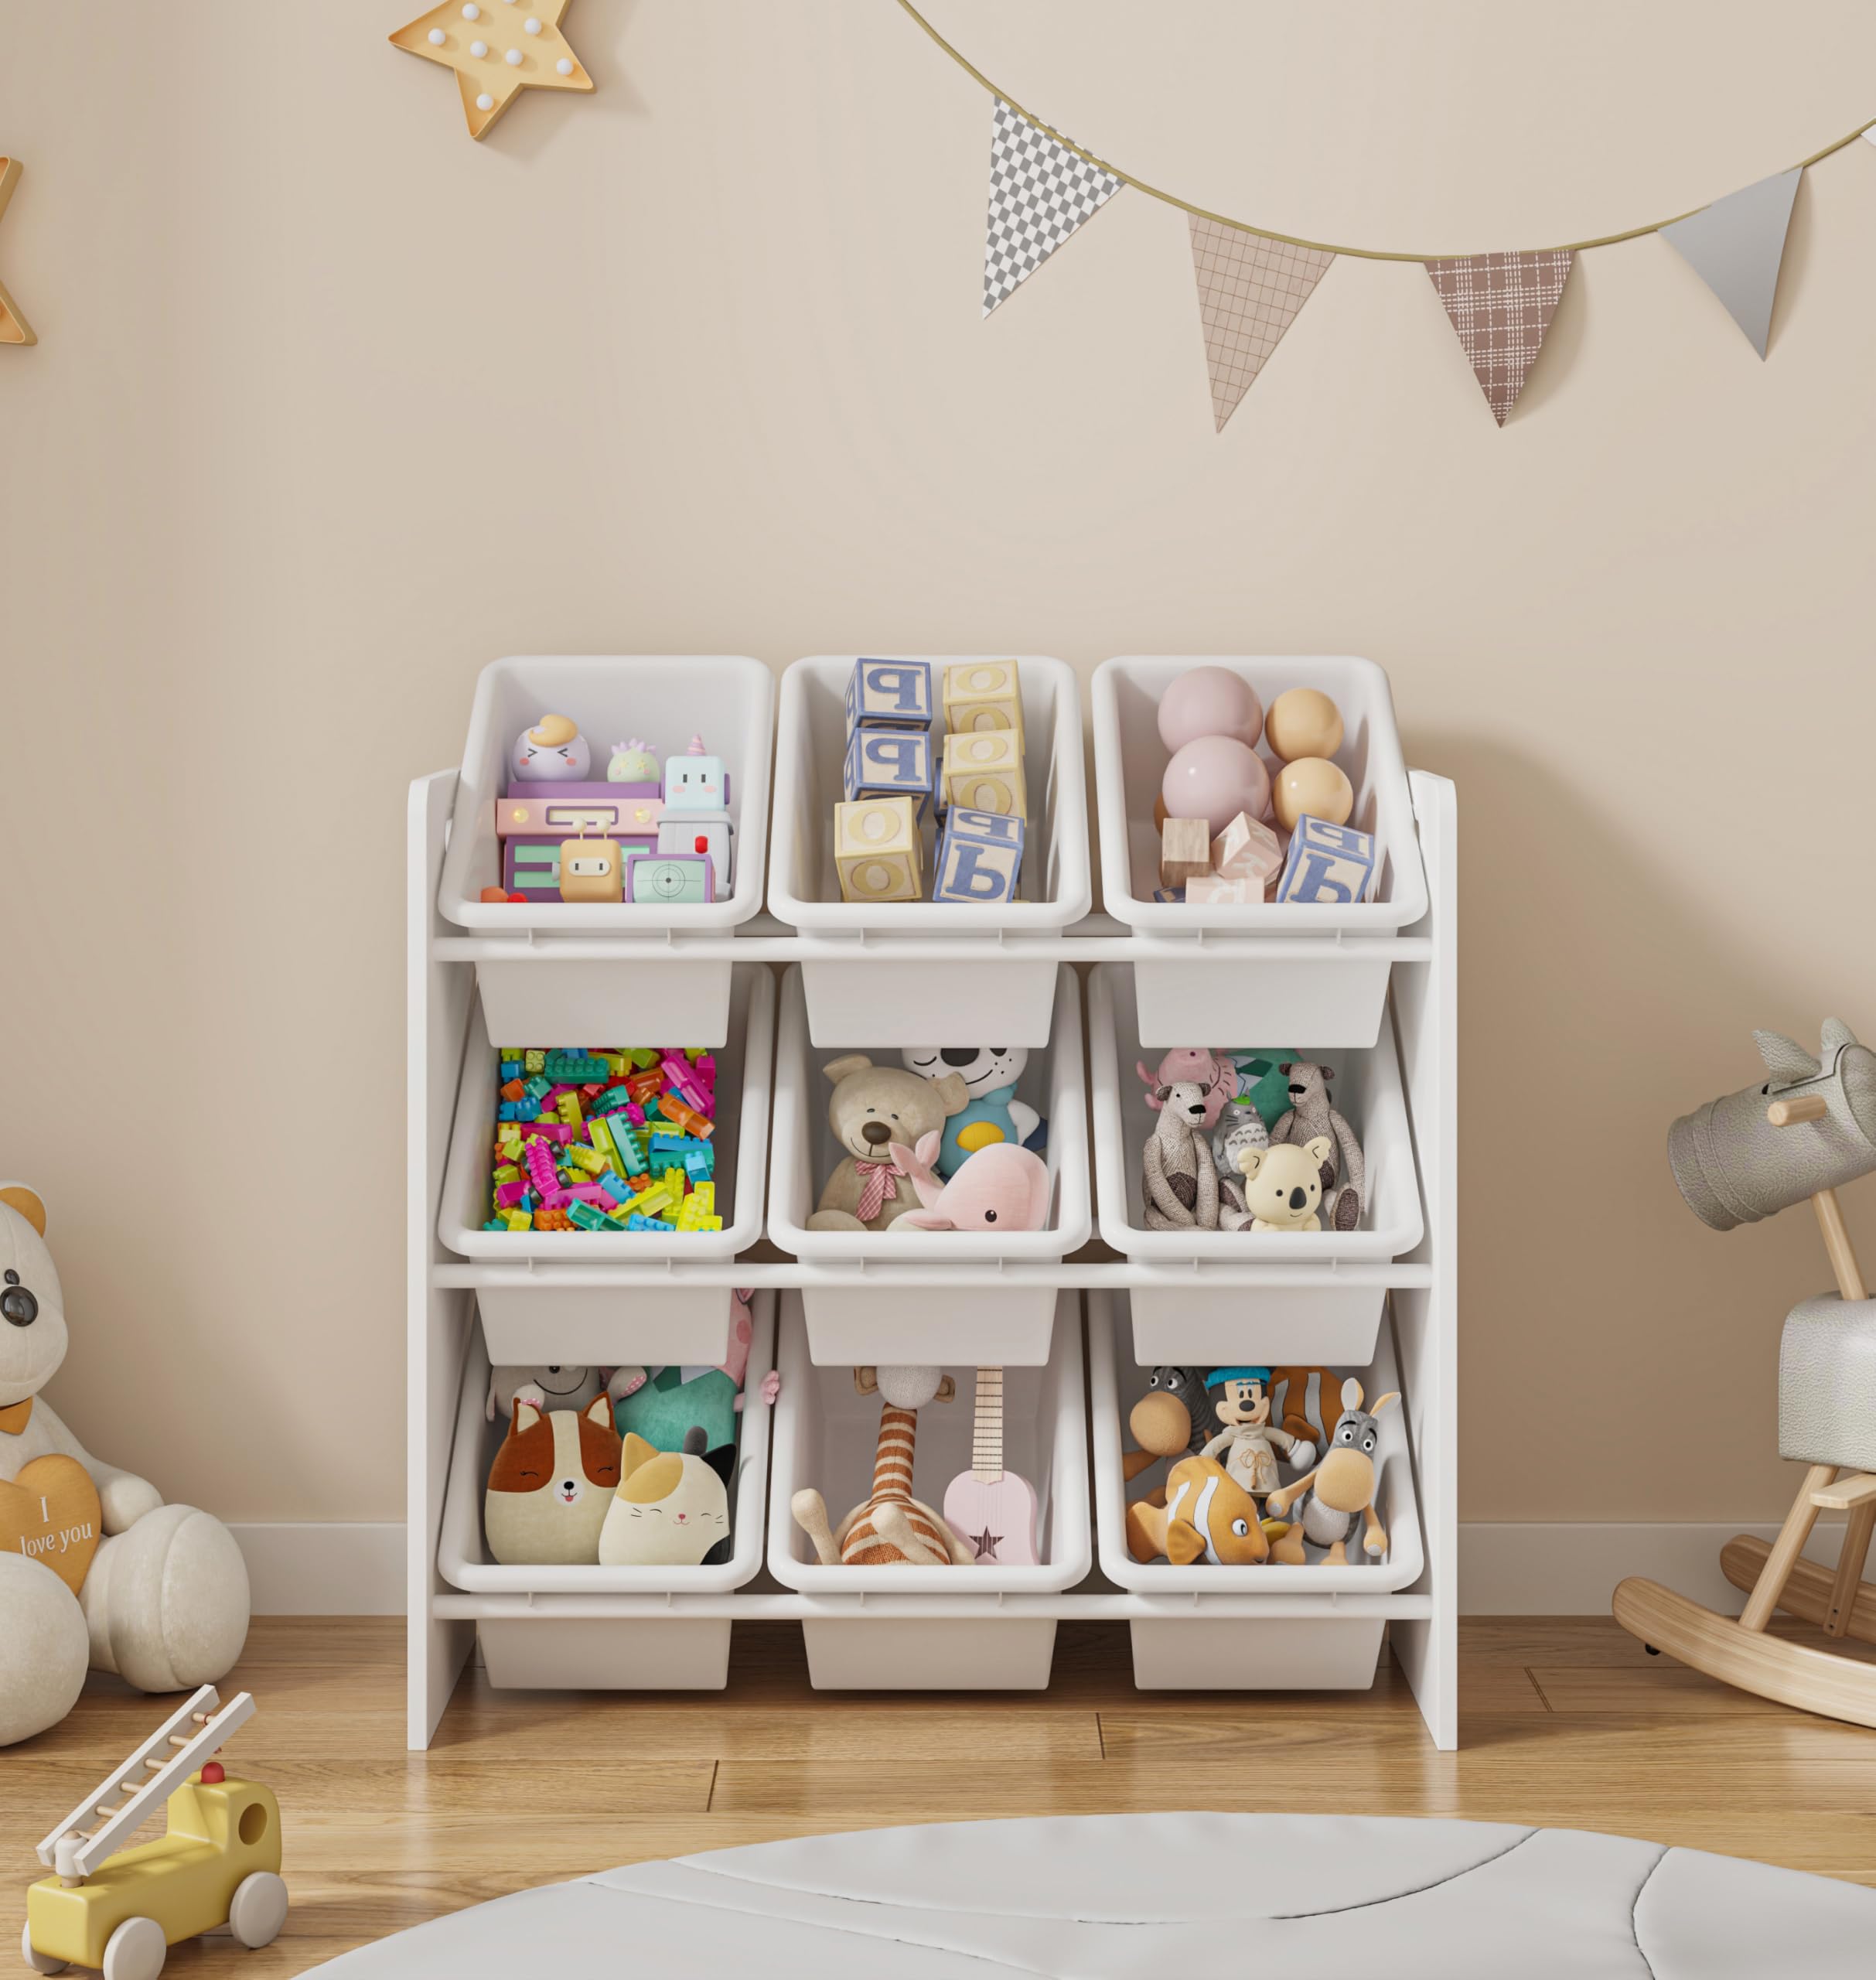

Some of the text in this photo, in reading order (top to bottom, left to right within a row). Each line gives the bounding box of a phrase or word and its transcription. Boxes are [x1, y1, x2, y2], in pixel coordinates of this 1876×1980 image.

[955, 666, 1006, 693] O
[955, 739, 1008, 763] O
[848, 806, 901, 845] O
[851, 859, 905, 896] O
[39, 1497, 49, 1523] I
[19, 1522, 93, 1556] love you
